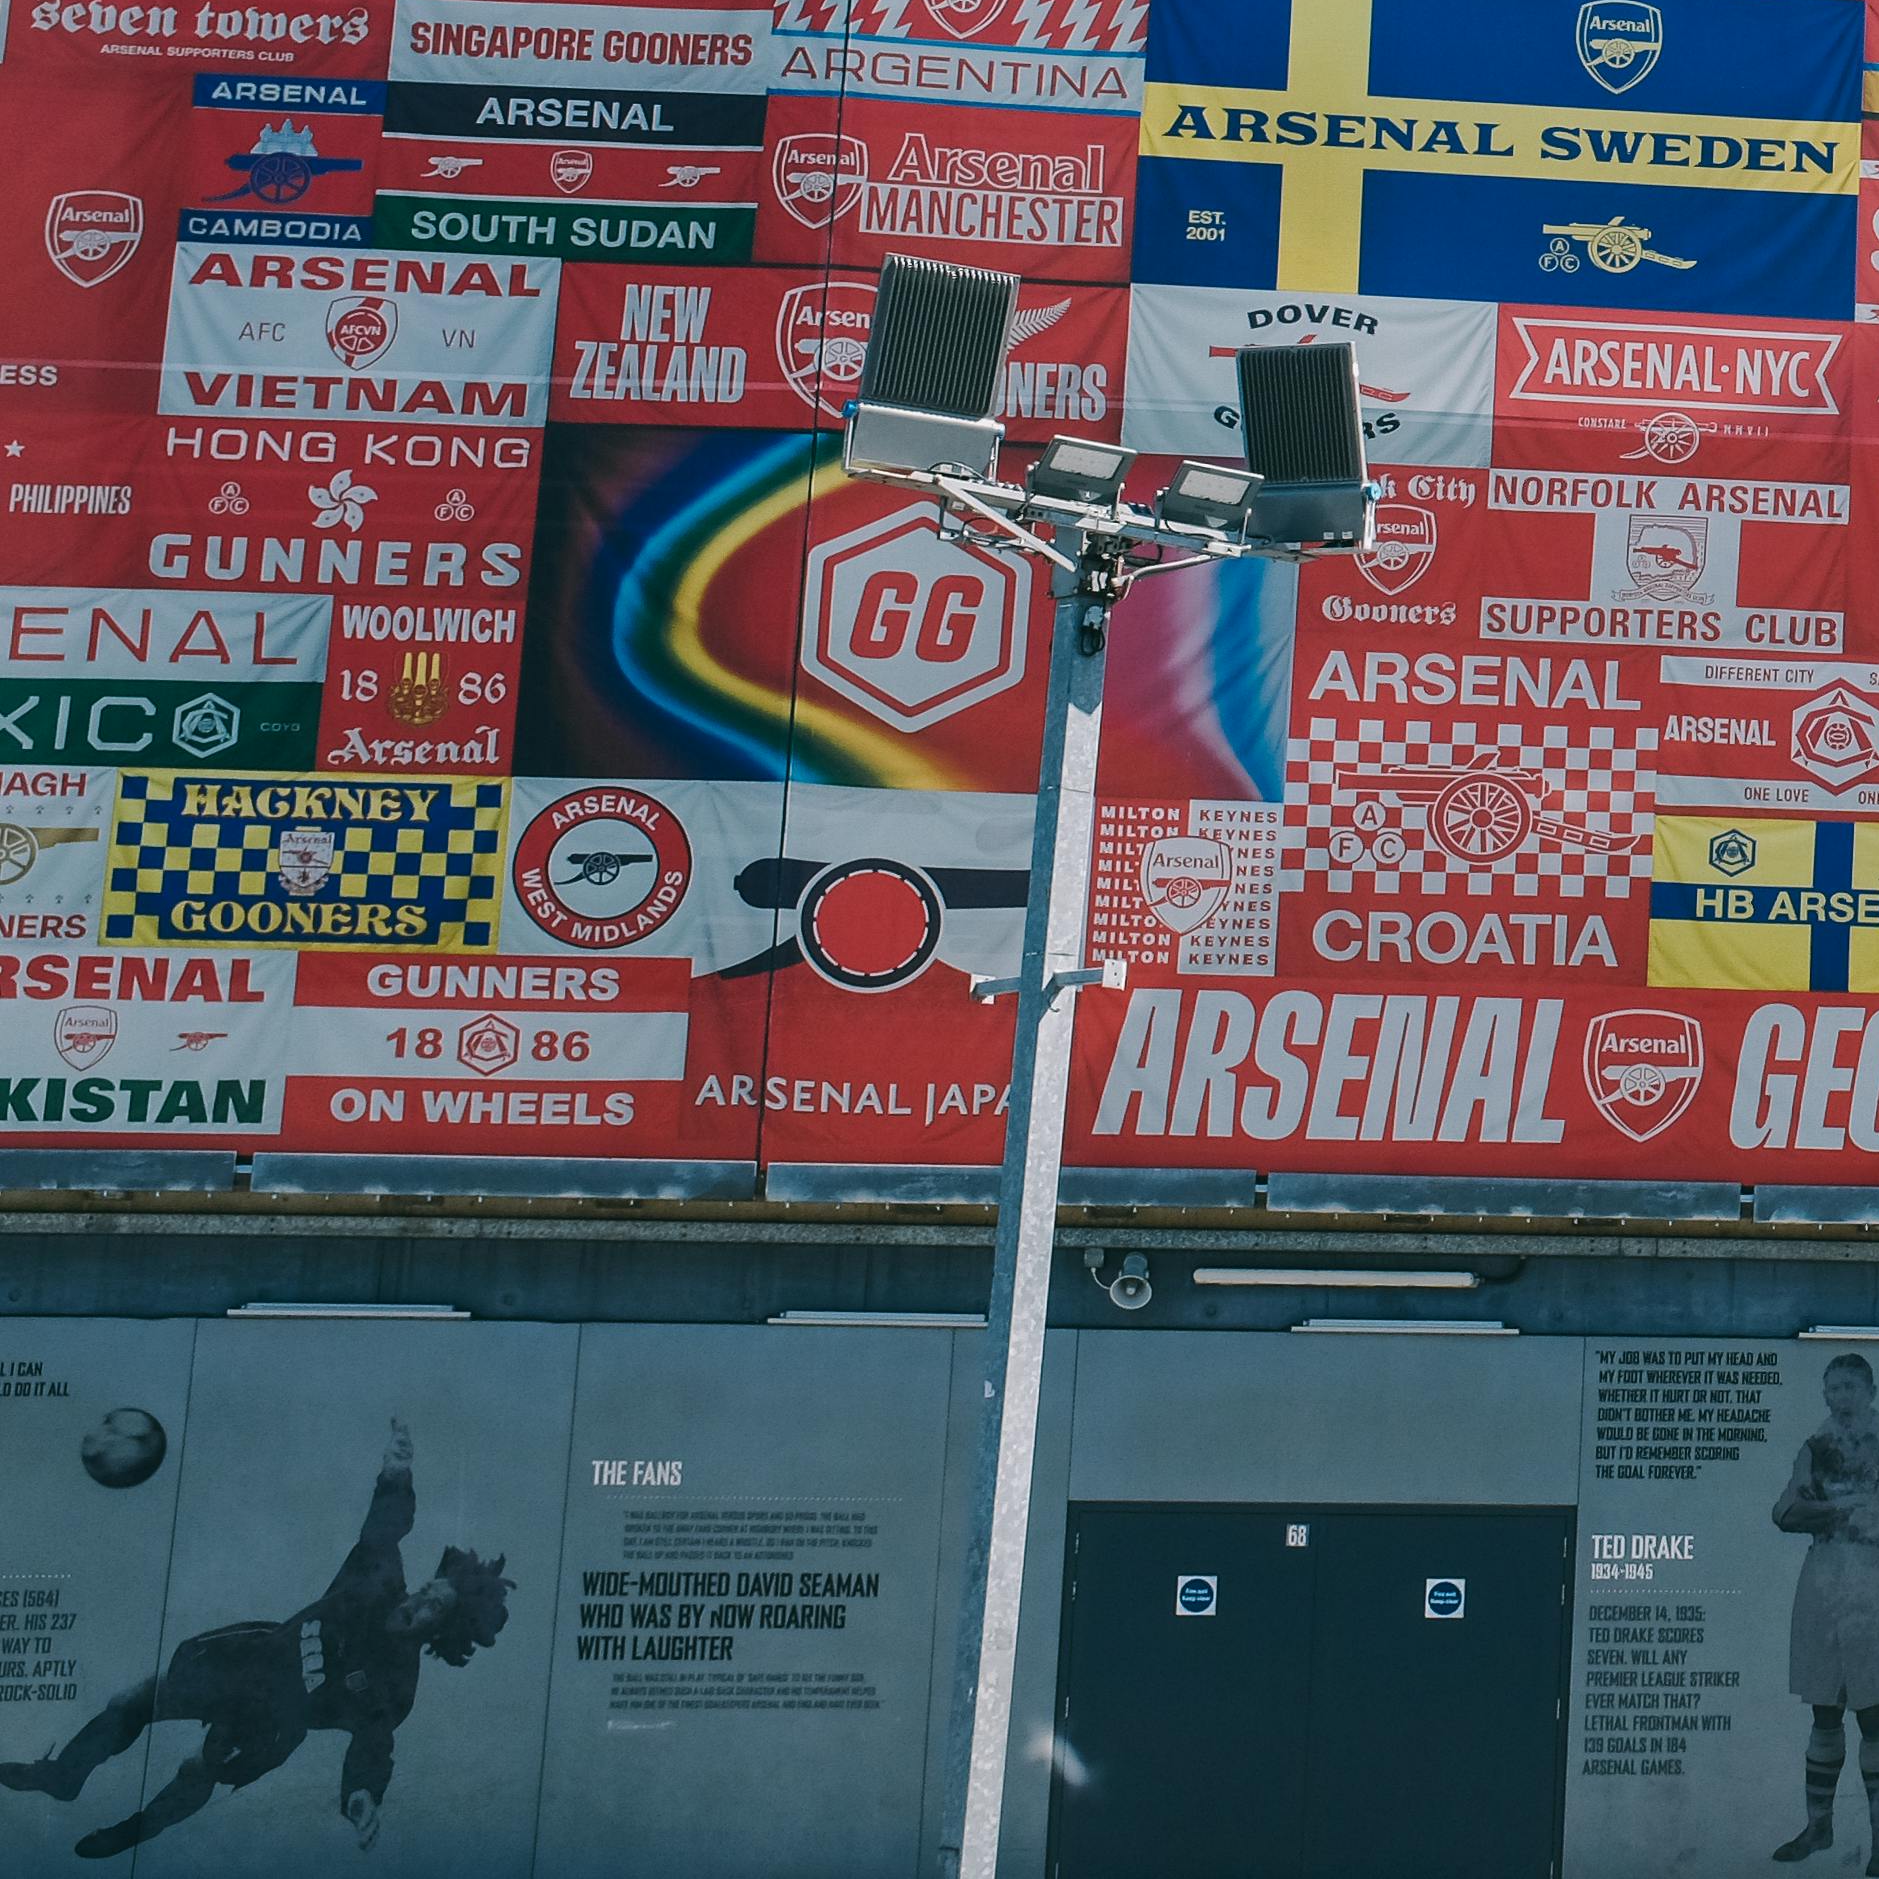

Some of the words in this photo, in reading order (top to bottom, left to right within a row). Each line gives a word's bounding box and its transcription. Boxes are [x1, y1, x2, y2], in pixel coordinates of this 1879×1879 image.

[195, 3, 369, 47] towers
[410, 21, 592, 61] SINGAPORE
[603, 30, 752, 66] GOONERS
[476, 97, 674, 132] ARSENAL
[1164, 104, 1513, 159] ARSENAL
[1540, 126, 1839, 176] SWEDEN
[411, 211, 555, 247] SOUTH
[570, 217, 716, 250] SUDAN
[1186, 209, 1227, 226] EST.
[1186, 225, 1227, 241] 2001
[190, 254, 540, 296] ARSENAL
[622, 283, 712, 344] NEW
[1247, 305, 1379, 337] DOVER
[569, 341, 747, 404] ZEALAND
[184, 373, 527, 416] VIETNAM
[167, 427, 336, 463] HONG
[364, 434, 529, 467] KONG
[10, 483, 131, 515] PHILIPPINES
[148, 533, 521, 586] GUNNERS
[342, 605, 516, 643] WOOLWICH
[1309, 649, 1641, 711] ARSENAL
[181, 783, 438, 822] HACKNEY
[170, 900, 427, 939] GOONERS
[1696, 888, 1753, 919] HB
[1313, 910, 1618, 968] CROATIA
[367, 965, 620, 1001] GUNNERS
[1092, 989, 1566, 1145] ARSENAL
[331, 1089, 405, 1123] ON
[422, 1090, 634, 1128] WHEELS
[592, 1460, 627, 1485] THE
[633, 1460, 682, 1486] FANS
[1591, 1535, 1626, 1560] TED
[1631, 1535, 1694, 1560] DRAKE
